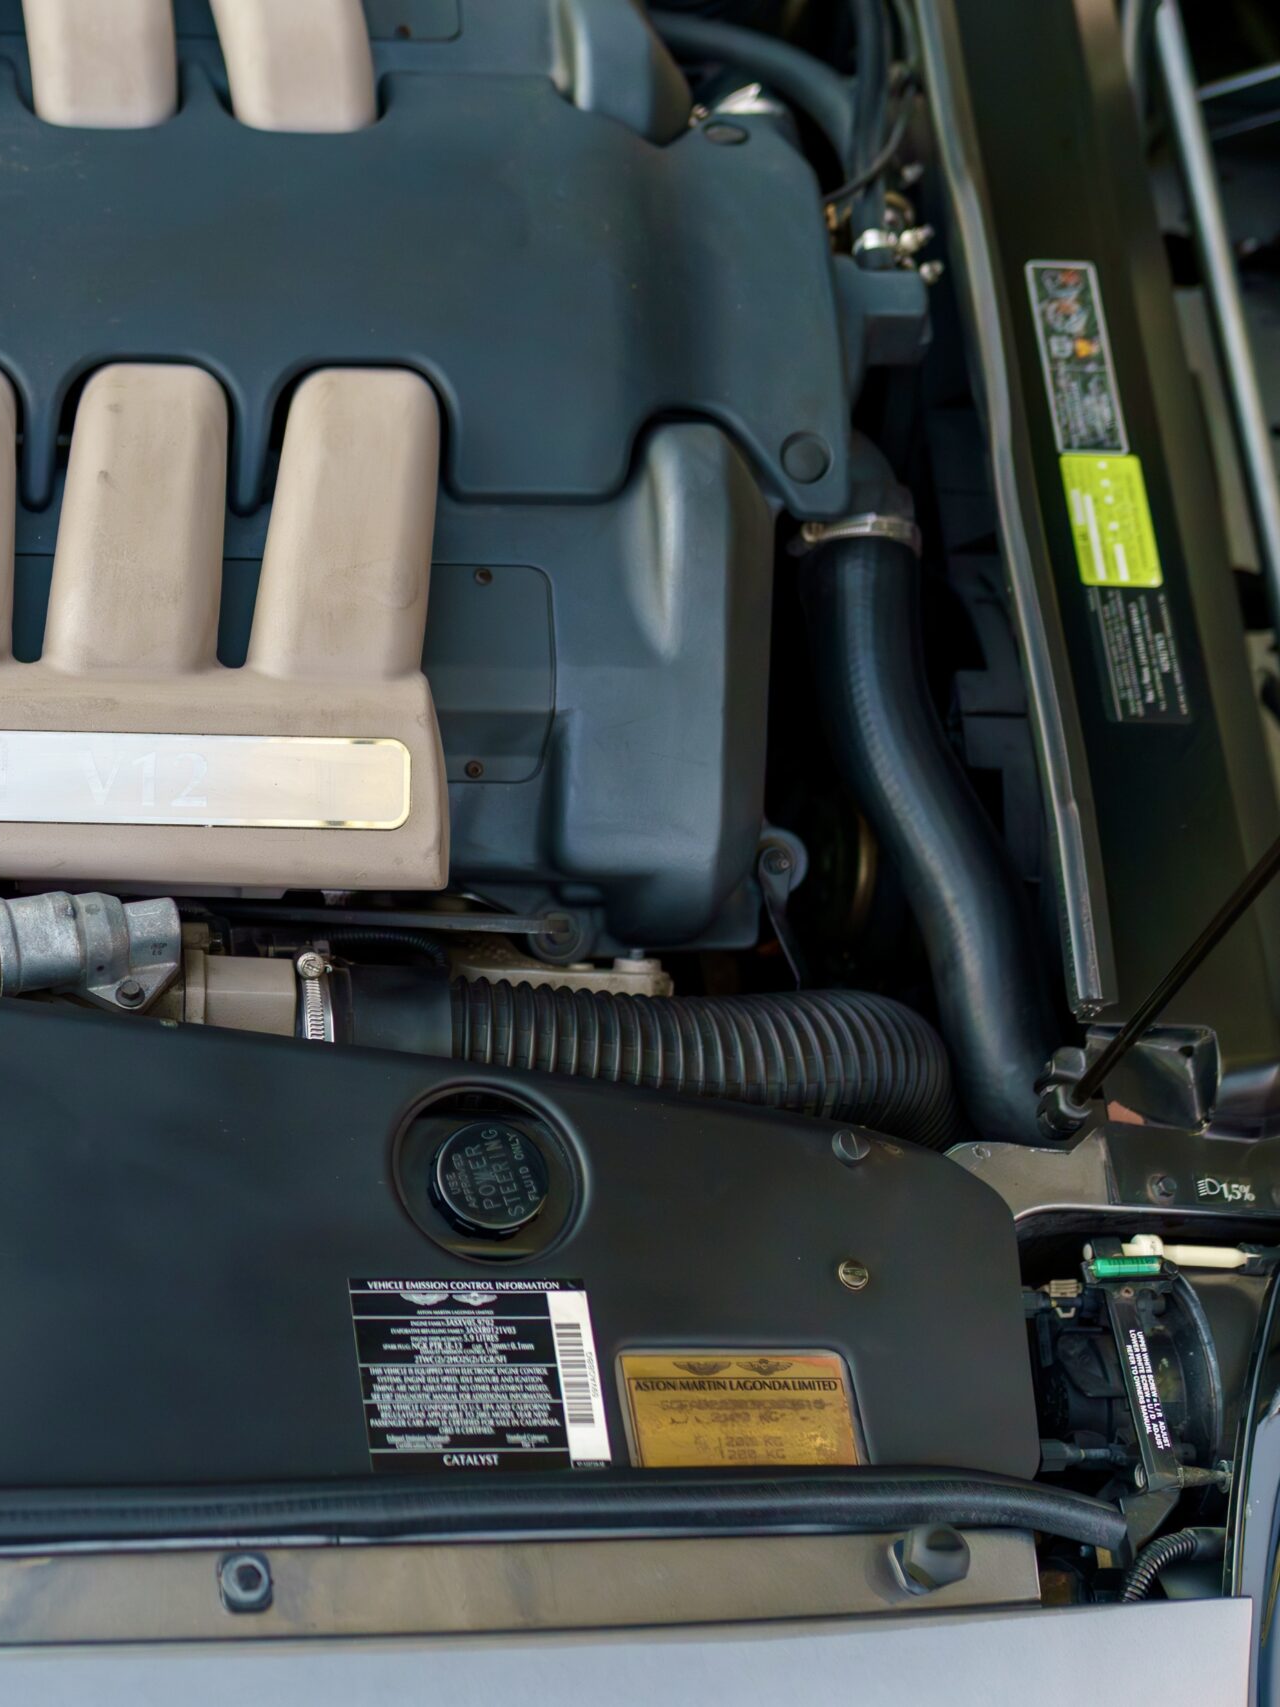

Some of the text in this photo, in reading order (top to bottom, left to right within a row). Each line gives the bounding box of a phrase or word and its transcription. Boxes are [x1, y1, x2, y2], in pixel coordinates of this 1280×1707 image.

[86, 750, 209, 807] V12
[465, 1144, 502, 1210] POWER
[481, 1129, 525, 1217] STEERING
[506, 1132, 540, 1201] FLUID ONLY
[1220, 1182, 1256, 1202] 1,5%
[368, 1281, 560, 1290] VEHICLE EMISSION CONTROL INFORMATION
[475, 1334, 499, 1342] LITRES
[383, 1367, 407, 1375] VEHICLE
[413, 1367, 443, 1375] EQUIPPED
[444, 1367, 460, 1375] WITH
[460, 1367, 496, 1375] ELECTRONIC
[634, 1380, 838, 1392] ASTON MARTIN LAGONDA LIMITED
[1126, 1344, 1152, 1434] REFER TO OWNERS MANUAL
[1129, 1330, 1140, 1352] LOWER
[1135, 1354, 1145, 1374] WHITE
[1140, 1374, 1151, 1398] SCREW
[1152, 1423, 1164, 1450] ADJUST
[1137, 1332, 1147, 1352] UPPER
[1142, 1353, 1152, 1373] WHITE
[1147, 1374, 1158, 1398] SCREW
[1158, 1421, 1170, 1448] ADJUST
[442, 1454, 500, 1466] CATALYST
